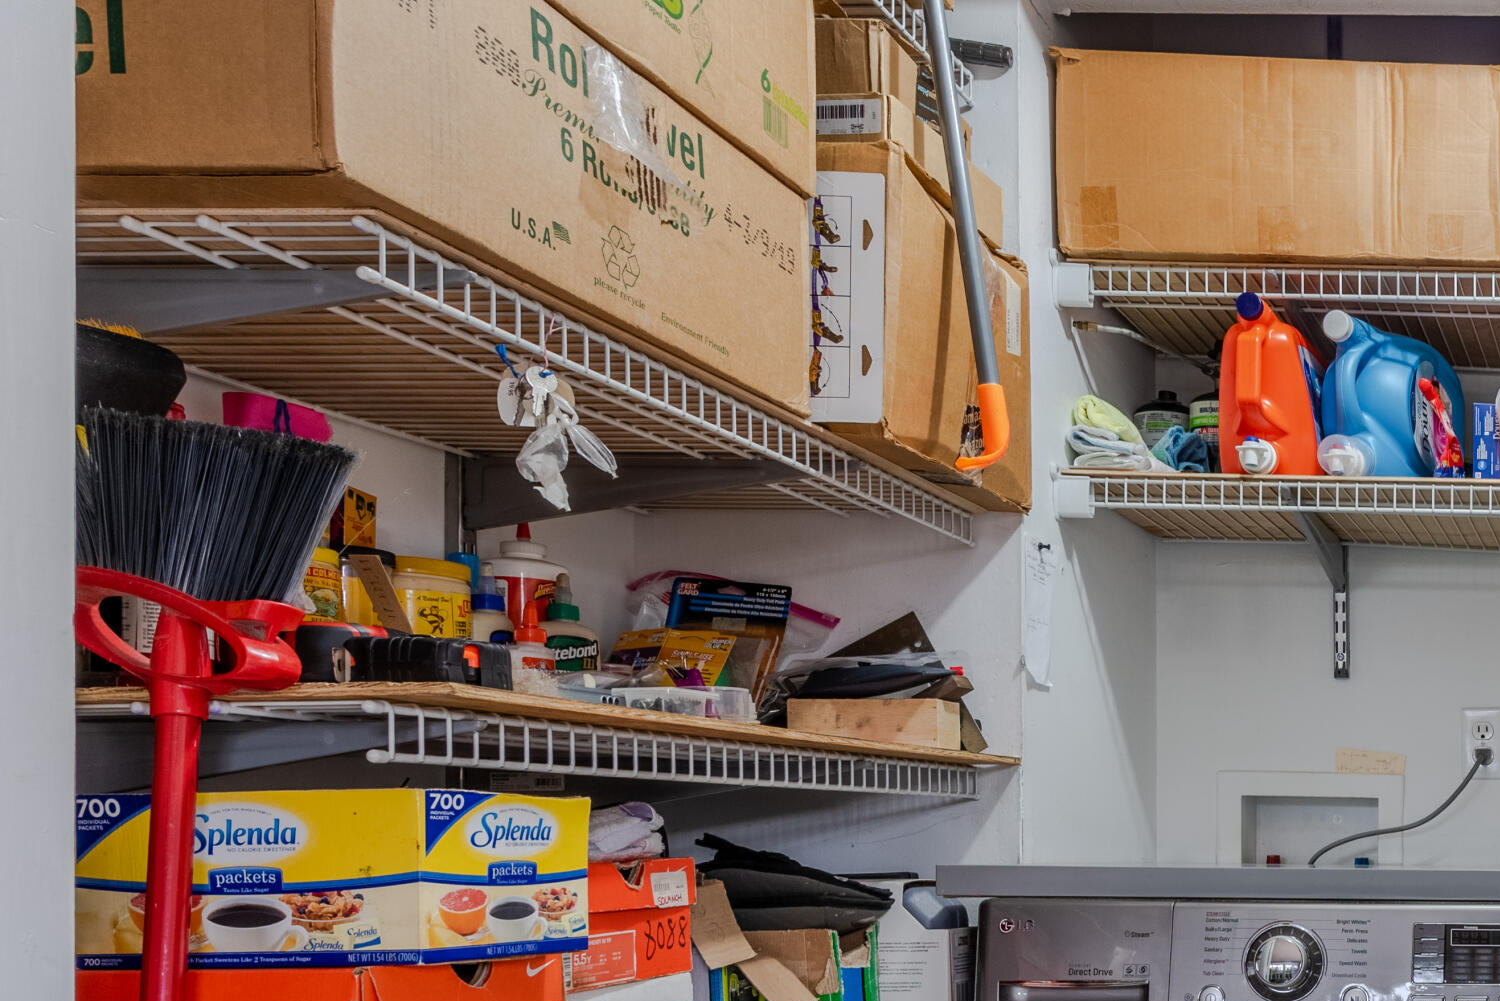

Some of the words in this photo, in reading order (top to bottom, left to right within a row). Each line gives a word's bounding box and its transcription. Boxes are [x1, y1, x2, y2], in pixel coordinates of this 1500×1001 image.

[511, 207, 556, 250] U.S.A.
[594, 275, 619, 297] please
[619, 290, 646, 310] recycle
[661, 311, 704, 342] Environment
[76, 798, 121, 818] 700
[429, 793, 465, 811] 700
[470, 812, 552, 849] Splenda
[215, 869, 276, 888] packets
[491, 863, 533, 879] packets
[83, 958, 101, 967] 700
[347, 954, 362, 963] NET
[362, 954, 372, 963] WT
[397, 952, 418, 963] (700G)
[1067, 967, 1092, 976] Direct
[1092, 967, 1114, 976] Drive
